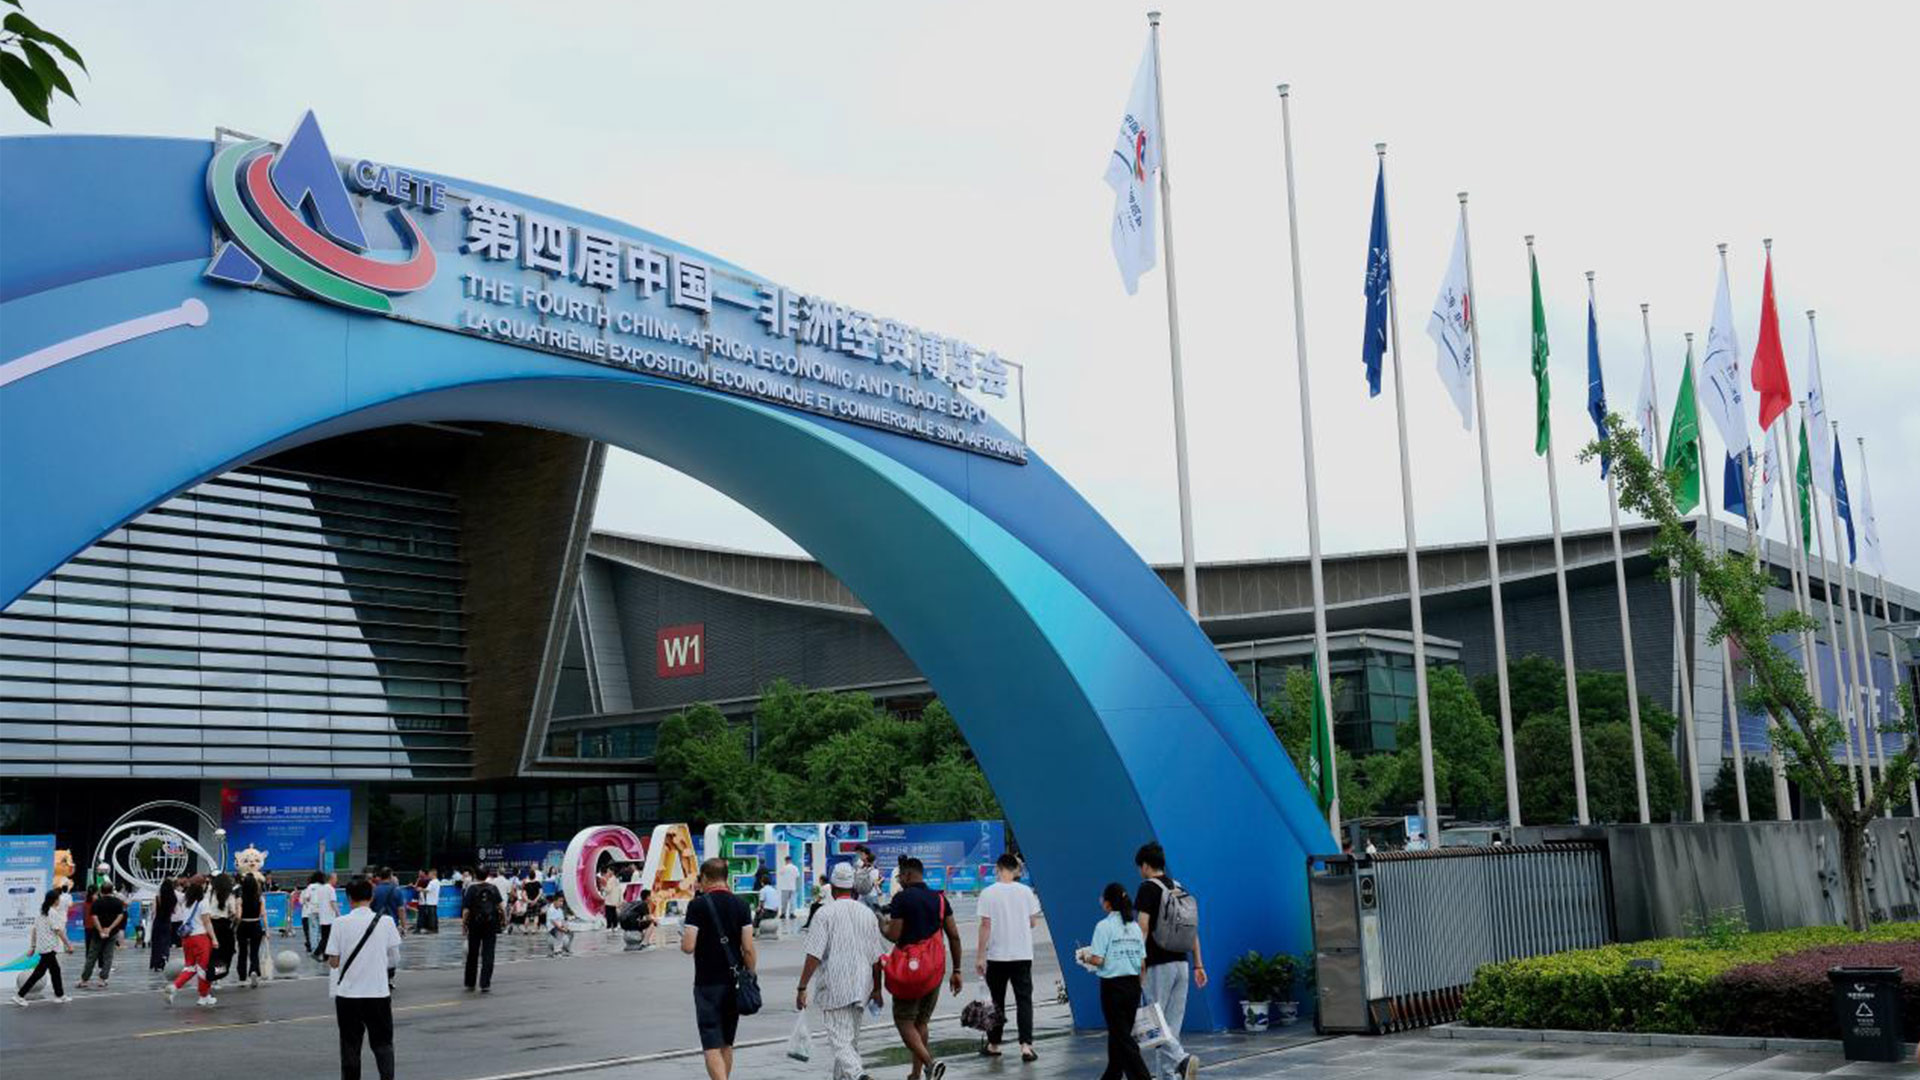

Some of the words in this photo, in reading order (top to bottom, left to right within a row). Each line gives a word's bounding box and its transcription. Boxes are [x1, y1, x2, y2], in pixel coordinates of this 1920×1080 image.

[354, 159, 447, 211] CAETE
[465, 271, 514, 304] THE
[522, 286, 611, 327] FOURTH
[618, 311, 756, 364] CHINA-AFRICA
[760, 347, 853, 388] ECONOMIC
[857, 374, 893, 398] AND
[897, 382, 946, 413] TRADE
[950, 397, 988, 424] EXPO
[465, 306, 492, 333] LA
[497, 317, 606, 357] QUATRIÈME
[610, 343, 709, 381] EXPOSITION
[713, 367, 814, 407] ECONOMIQUE
[818, 392, 836, 412] ET
[839, 399, 935, 435] COMMERCIALE
[937, 423, 1029, 460] SINO-AFRICAINE
[664, 634, 700, 668] W1
